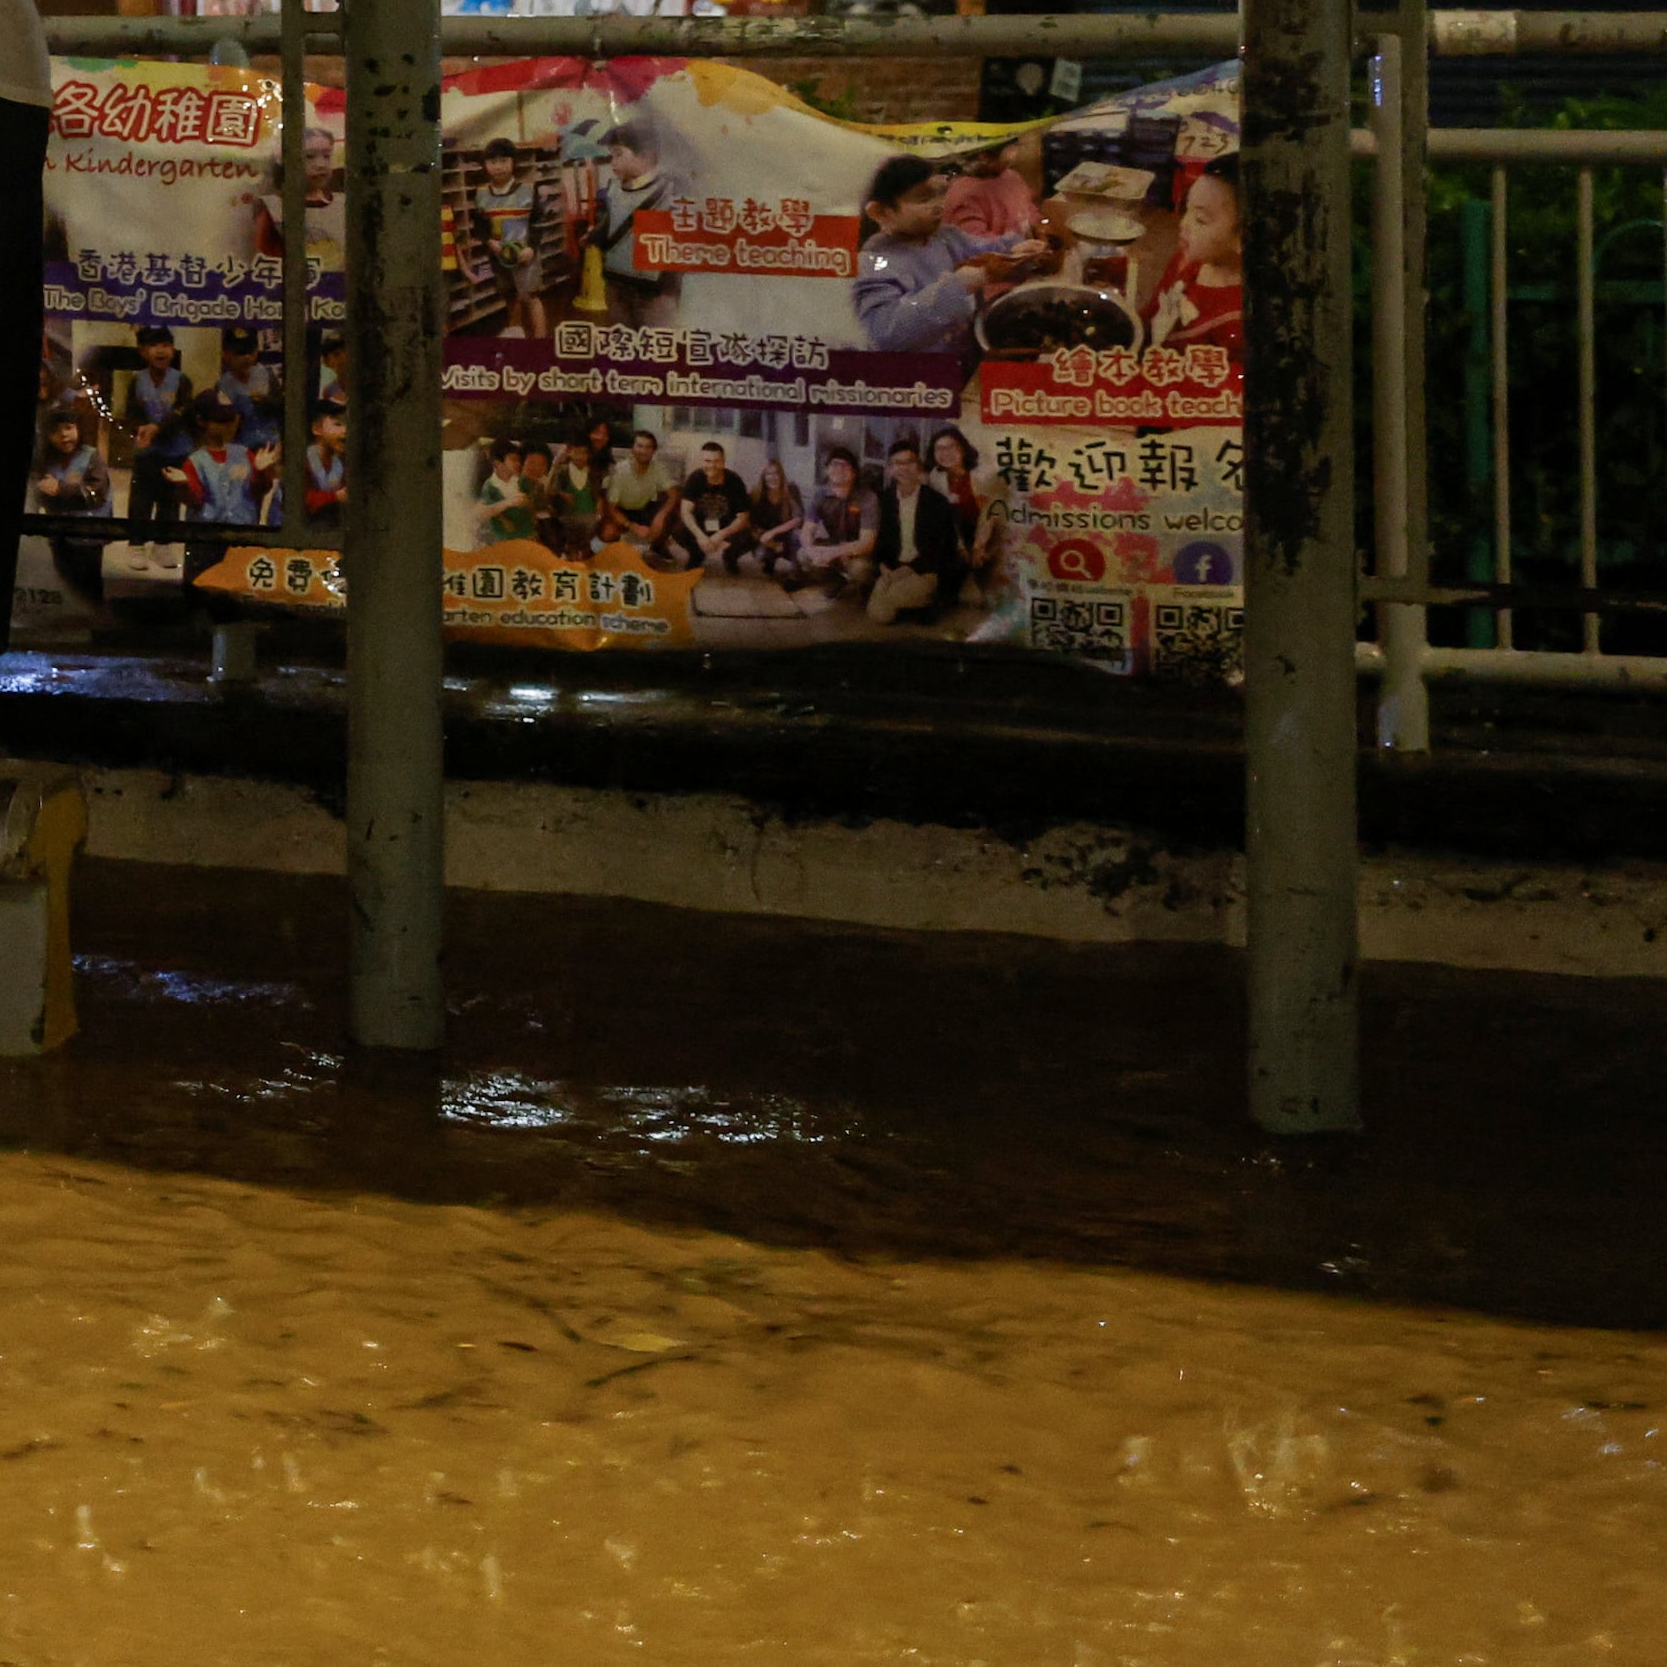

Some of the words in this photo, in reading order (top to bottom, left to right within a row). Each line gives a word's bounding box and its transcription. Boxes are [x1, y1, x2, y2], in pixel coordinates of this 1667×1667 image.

[66, 148, 259, 185] Kindergarten
[641, 235, 731, 267] Theme
[735, 240, 851, 275] teaching
[43, 287, 84, 310] The
[152, 292, 240, 320] Brigade
[504, 368, 533, 396] by
[539, 370, 602, 394] short
[607, 374, 662, 396] term
[666, 374, 805, 404] international
[811, 380, 953, 409] missionaries
[991, 389, 1091, 417] Picture
[1095, 390, 1162, 418] book
[1167, 391, 1243, 418] teach
[987, 500, 1151, 531] Admissions
[1163, 508, 1243, 531] welco
[500, 608, 596, 626] education
